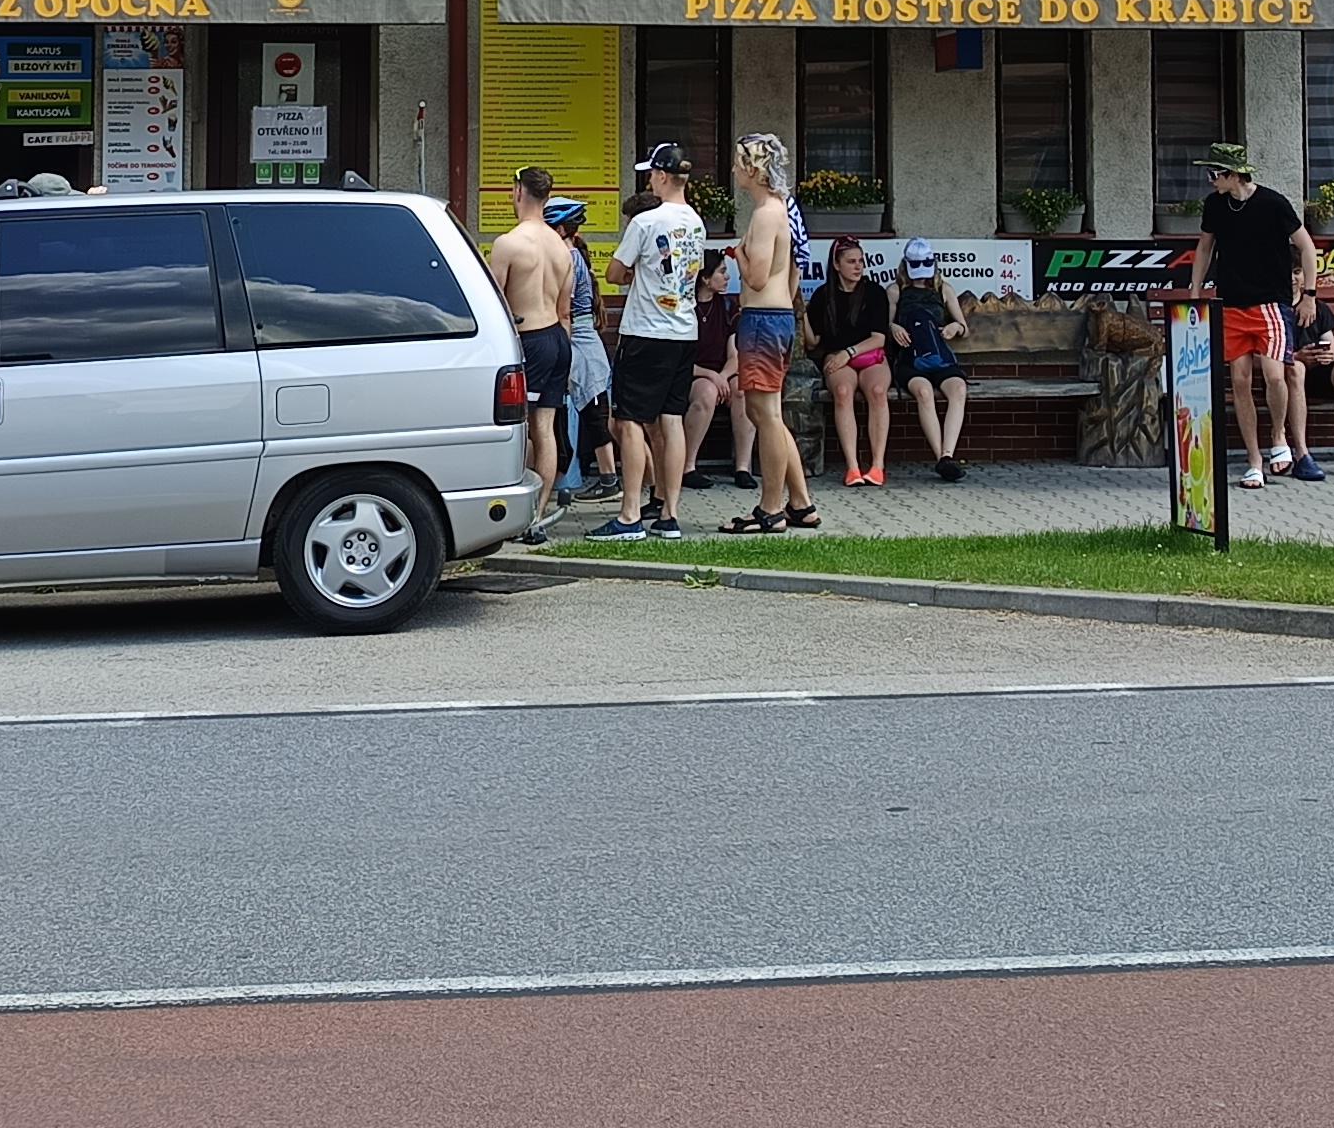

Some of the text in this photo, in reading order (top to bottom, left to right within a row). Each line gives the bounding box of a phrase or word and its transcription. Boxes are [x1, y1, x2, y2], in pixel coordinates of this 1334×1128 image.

[26, 46, 62, 55] KAKTUS
[13, 60, 51, 71] BEZOVÝ
[18, 90, 71, 101] VANILKOVÁ
[16, 106, 71, 117] KAKTUSOVÁ
[276, 112, 303, 121] PIZZA
[257, 126, 309, 136] OTEVŘENO
[27, 136, 53, 144] CAFE
[933, 253, 1021, 266] RESSO 40,-
[1044, 249, 1196, 278] PIZZA
[934, 267, 1021, 281] UCCINO 44,-
[1001, 284, 1021, 295] 50-
[1047, 282, 1084, 292] KDO
